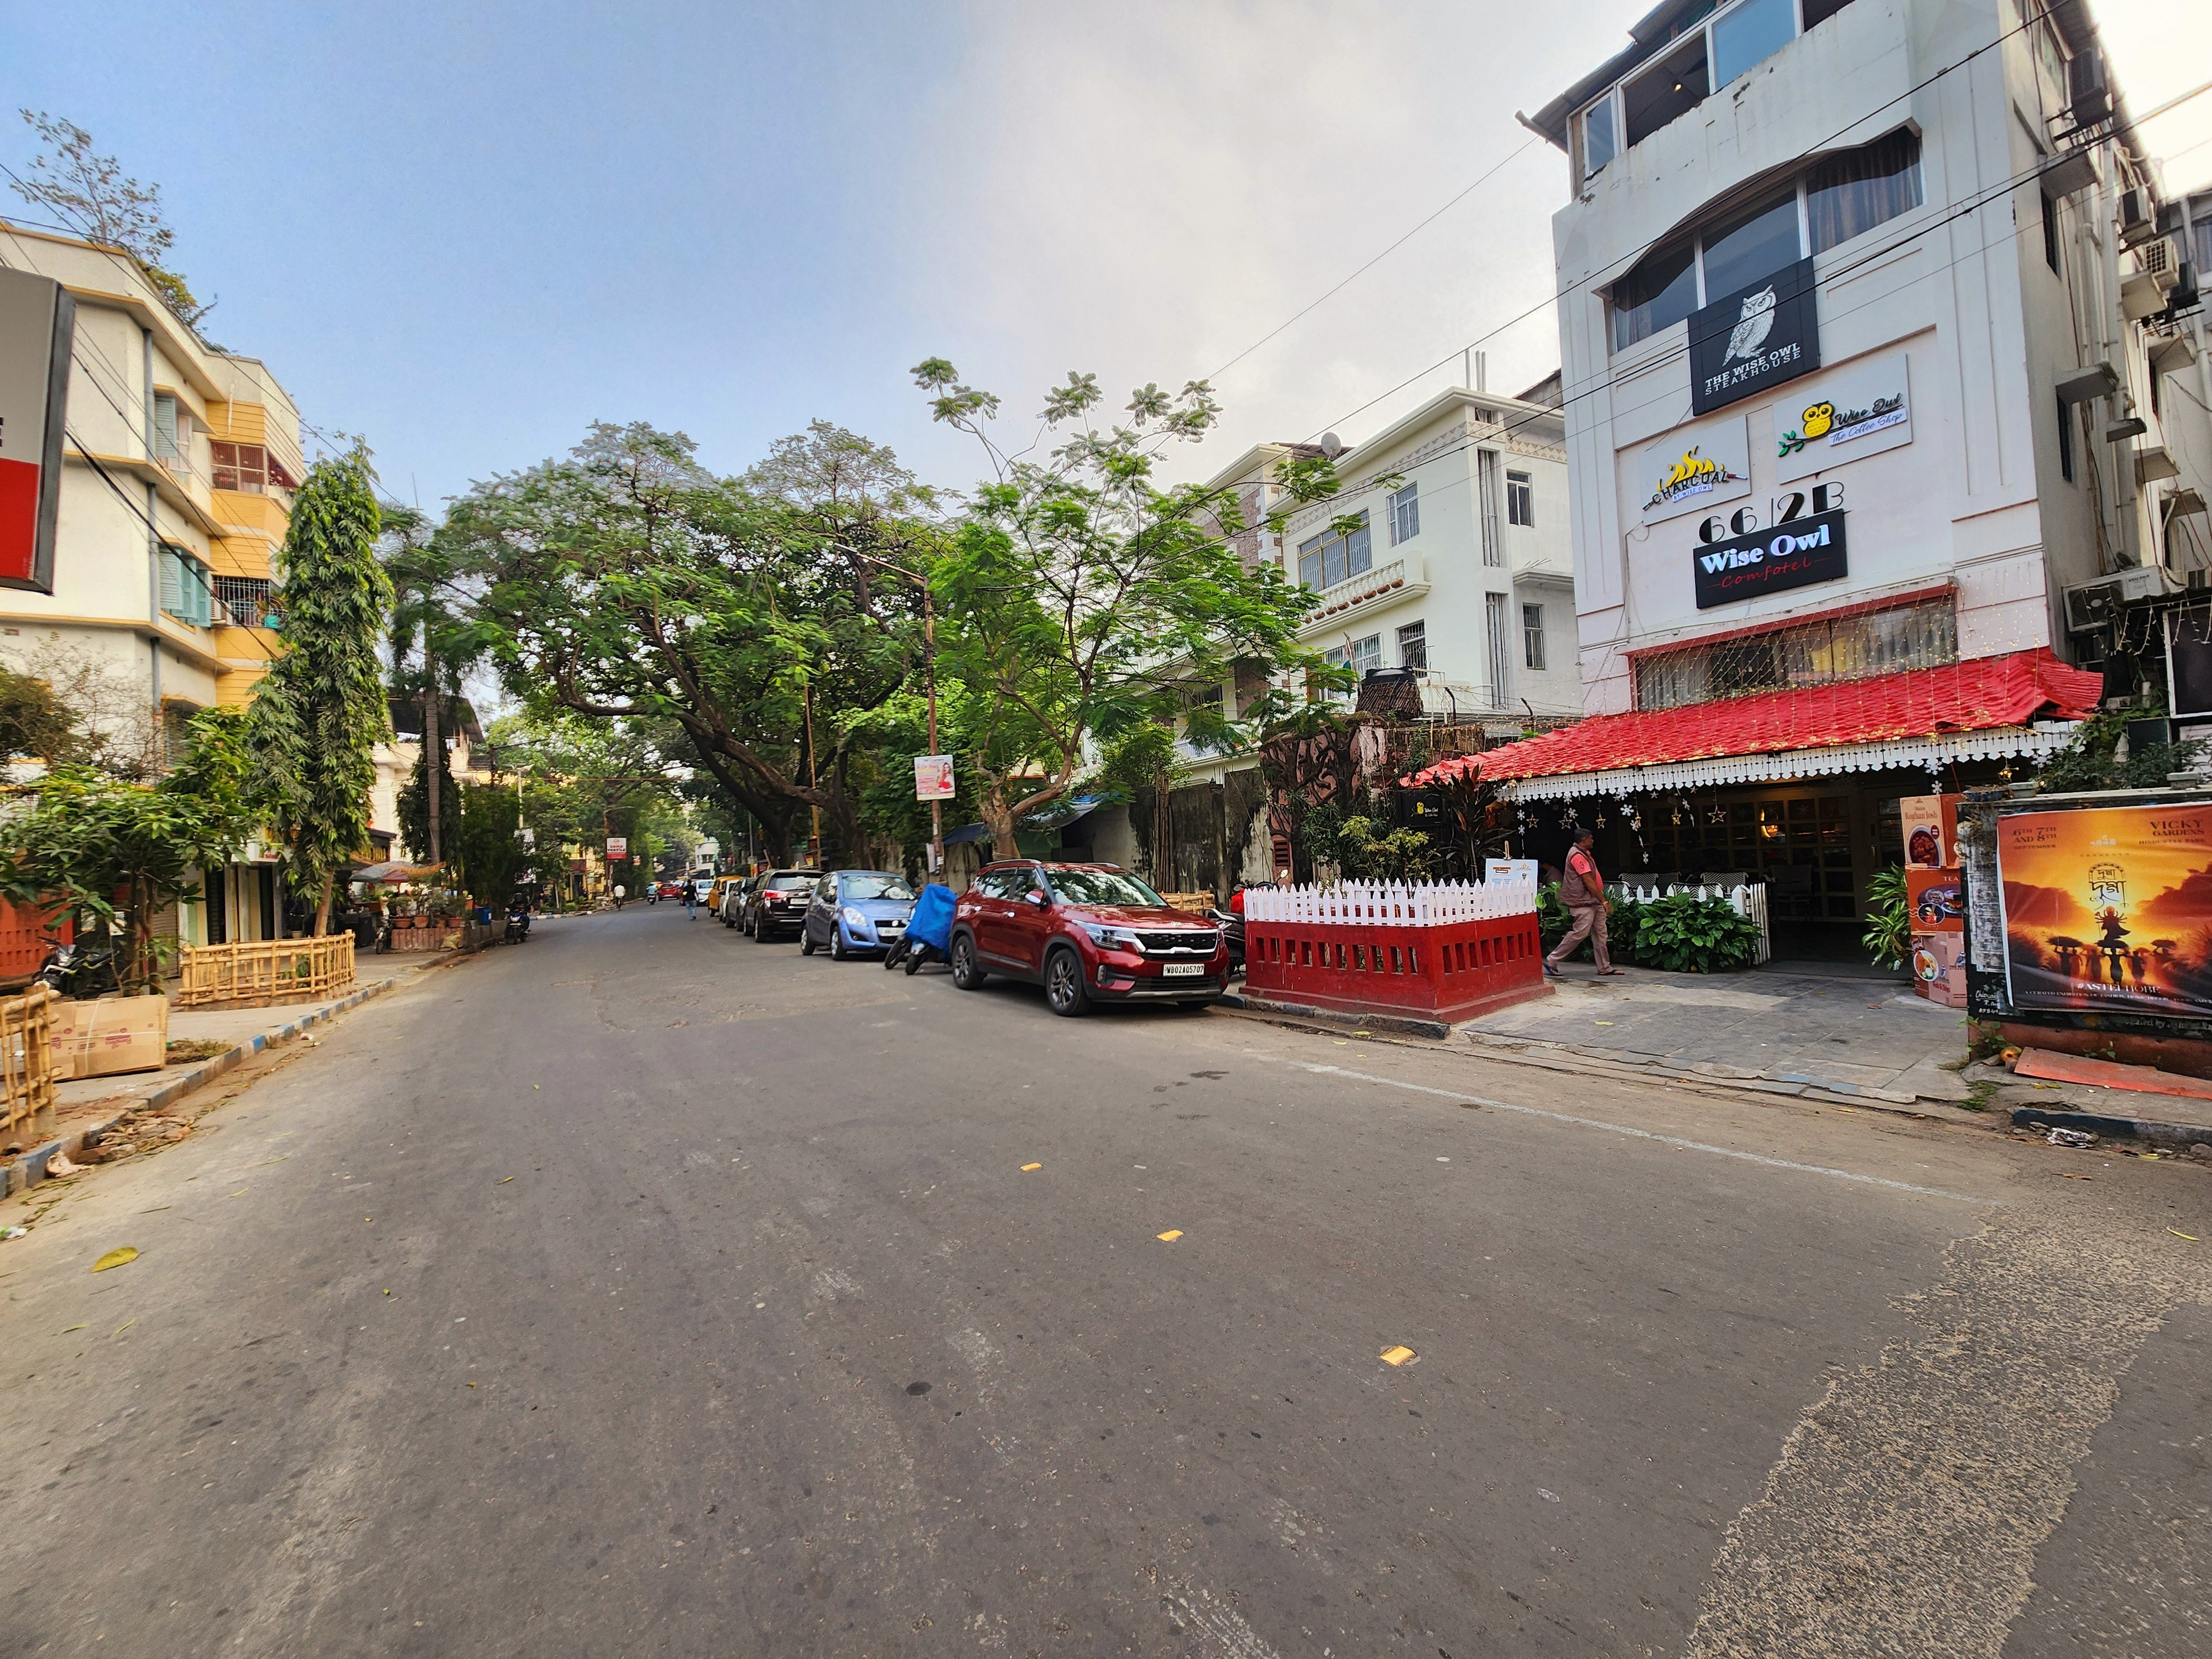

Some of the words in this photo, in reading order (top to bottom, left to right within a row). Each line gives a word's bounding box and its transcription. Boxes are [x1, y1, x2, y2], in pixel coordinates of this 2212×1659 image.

[1705, 371, 1730, 388] THE
[1732, 356, 1766, 376] WISE
[1770, 342, 1801, 361] OWL
[1705, 351, 1801, 395] STEAKHOUSE
[1834, 409, 1869, 425] Wise
[1872, 392, 1902, 413] Owl
[1830, 431, 1846, 443] The
[1848, 422, 1875, 437] Coffee
[1877, 413, 1904, 426] Shop
[1651, 471, 1730, 504] CHARCOAL
[1682, 488, 1696, 497] WISE
[1700, 547, 1765, 574] Wise
[1770, 524, 1832, 556] Owl
[1720, 556, 1812, 588] Comfotel
[2150, 820, 2201, 830] VICKY
